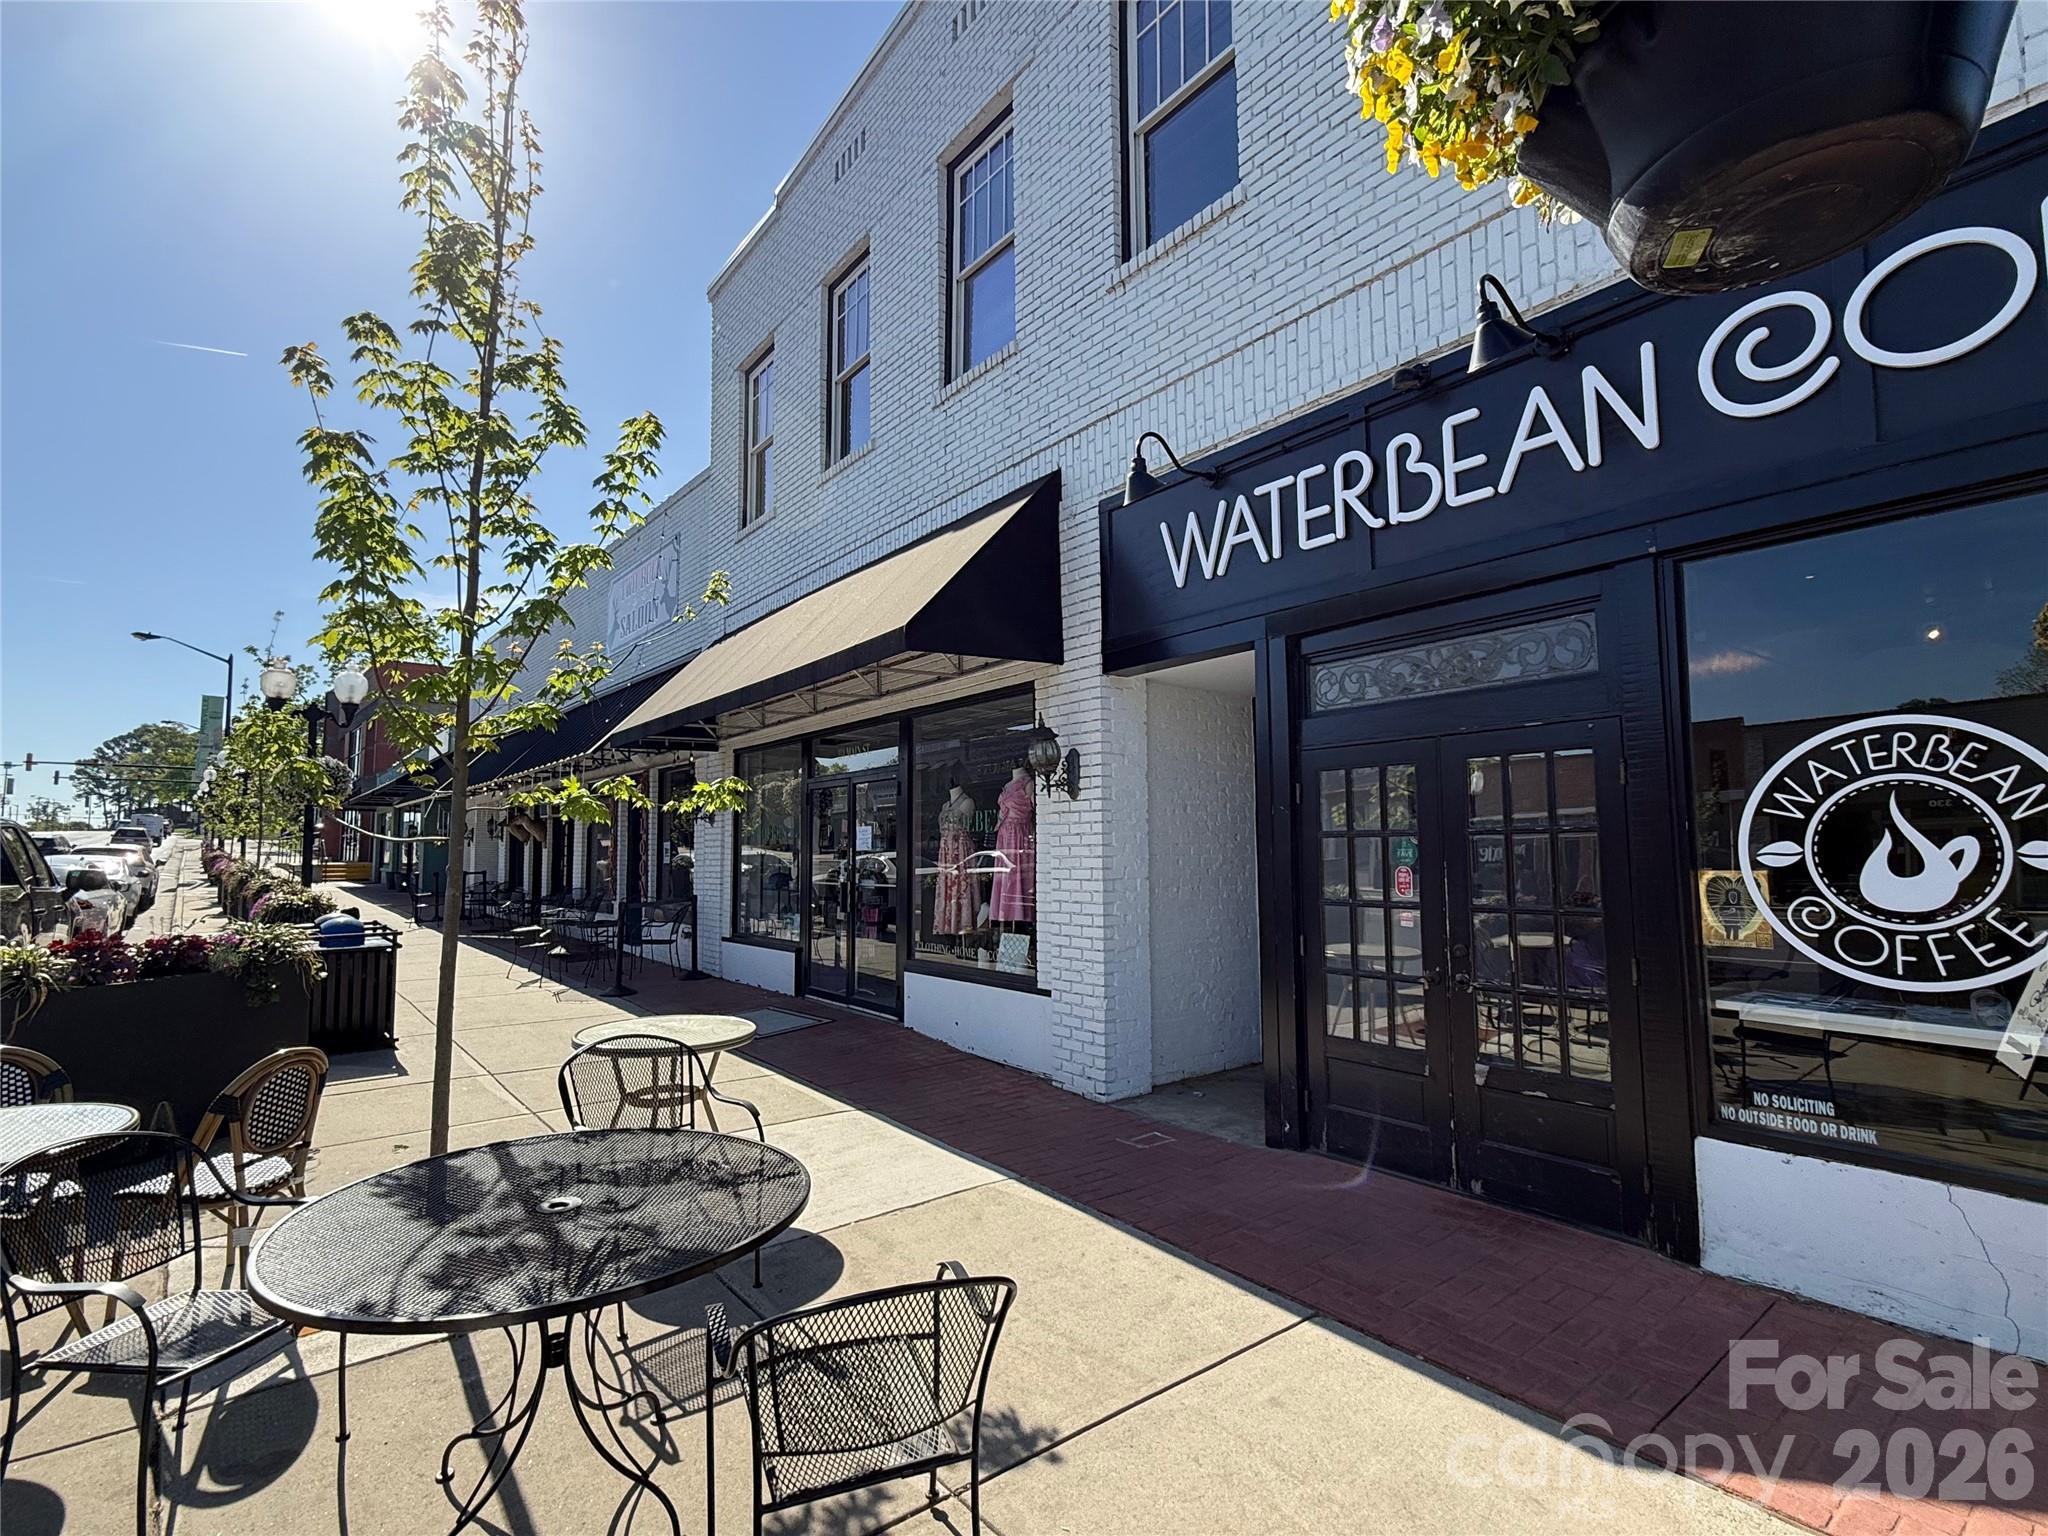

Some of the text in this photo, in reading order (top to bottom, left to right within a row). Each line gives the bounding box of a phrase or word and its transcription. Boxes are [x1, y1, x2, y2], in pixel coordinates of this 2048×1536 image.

[1159, 195, 2048, 588] WATERBEAN CO
[619, 597, 659, 639] SALOON
[1762, 731, 2048, 821] WATERBEAN
[916, 941, 951, 955] CLOTHING
[954, 946, 977, 959] HOME
[1787, 895, 2048, 976] COFFEE
[1720, 1105, 1879, 1145] NO OUTSIDE FOOD OR DRINK
[1753, 1091, 1835, 1117] NO SOLICITING
